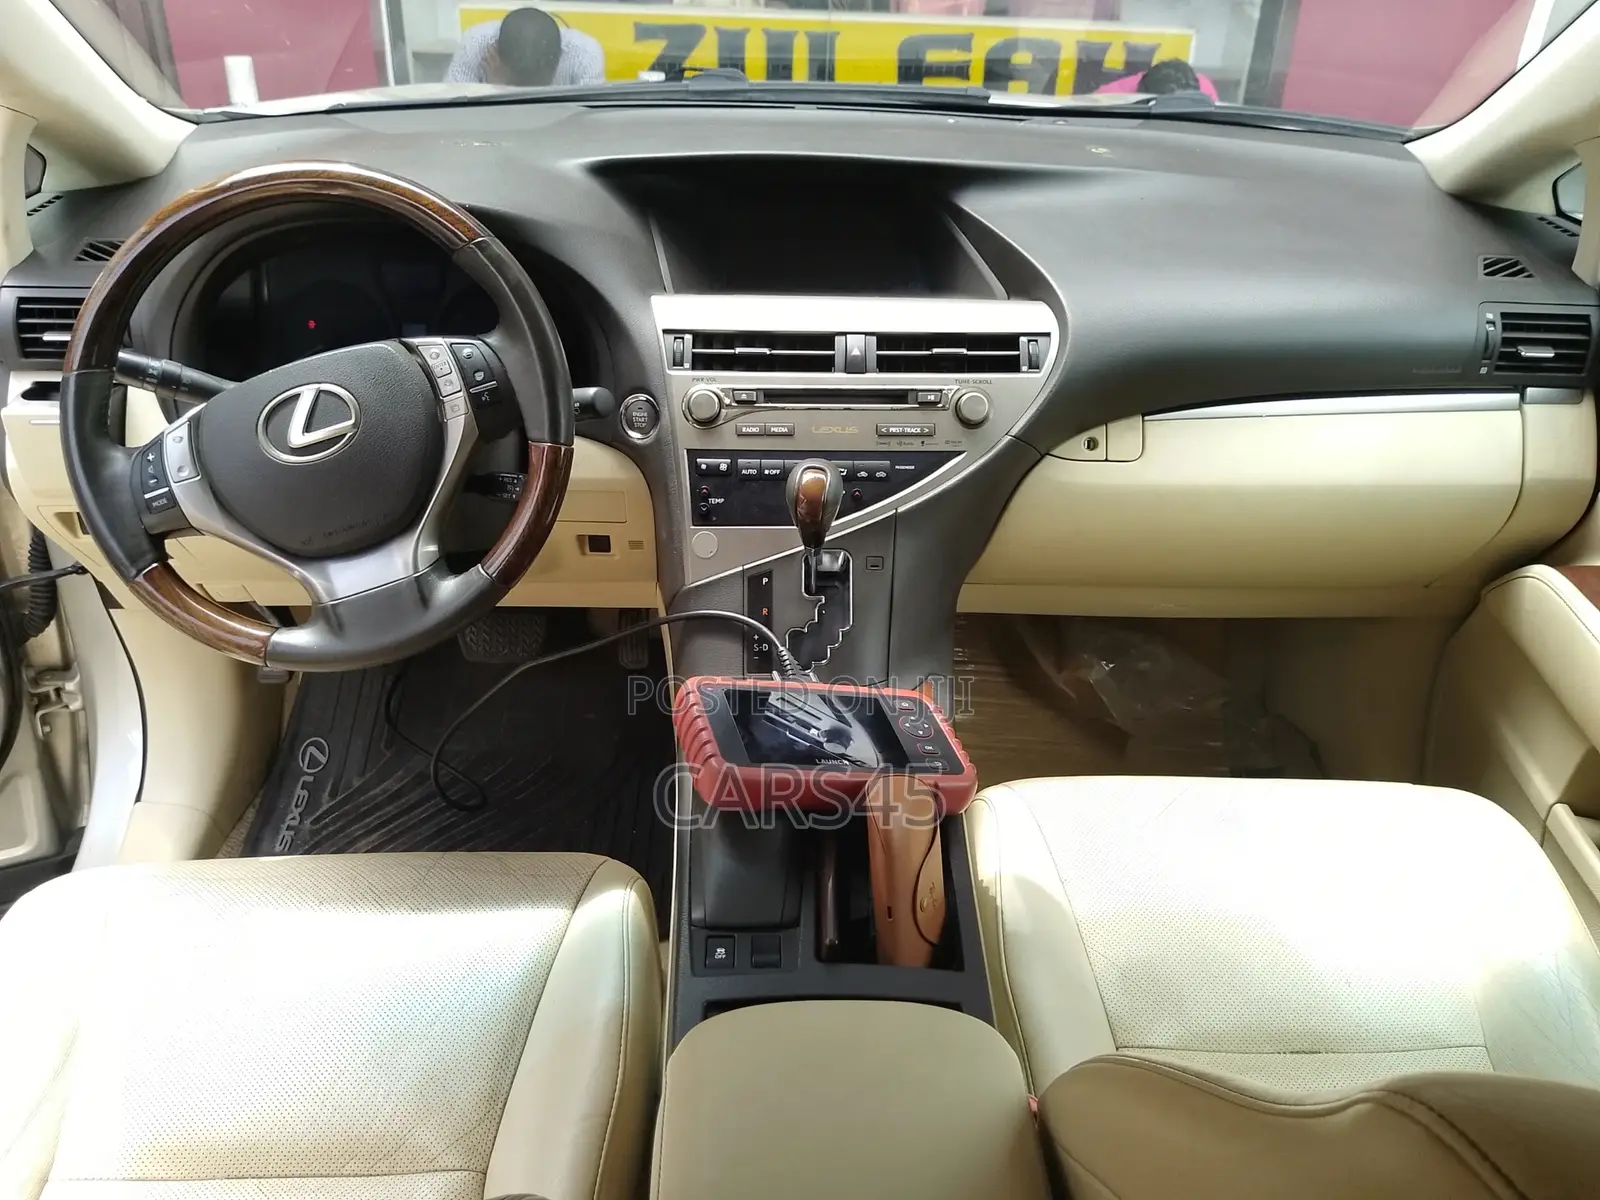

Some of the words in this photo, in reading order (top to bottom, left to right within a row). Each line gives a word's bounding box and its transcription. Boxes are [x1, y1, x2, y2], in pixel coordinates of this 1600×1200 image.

[811, 424, 859, 434] LEXUS
[762, 577, 769, 586] P
[762, 607, 769, 616] R
[816, 758, 850, 766] LAUNCH
[274, 775, 315, 852] LEXUS
